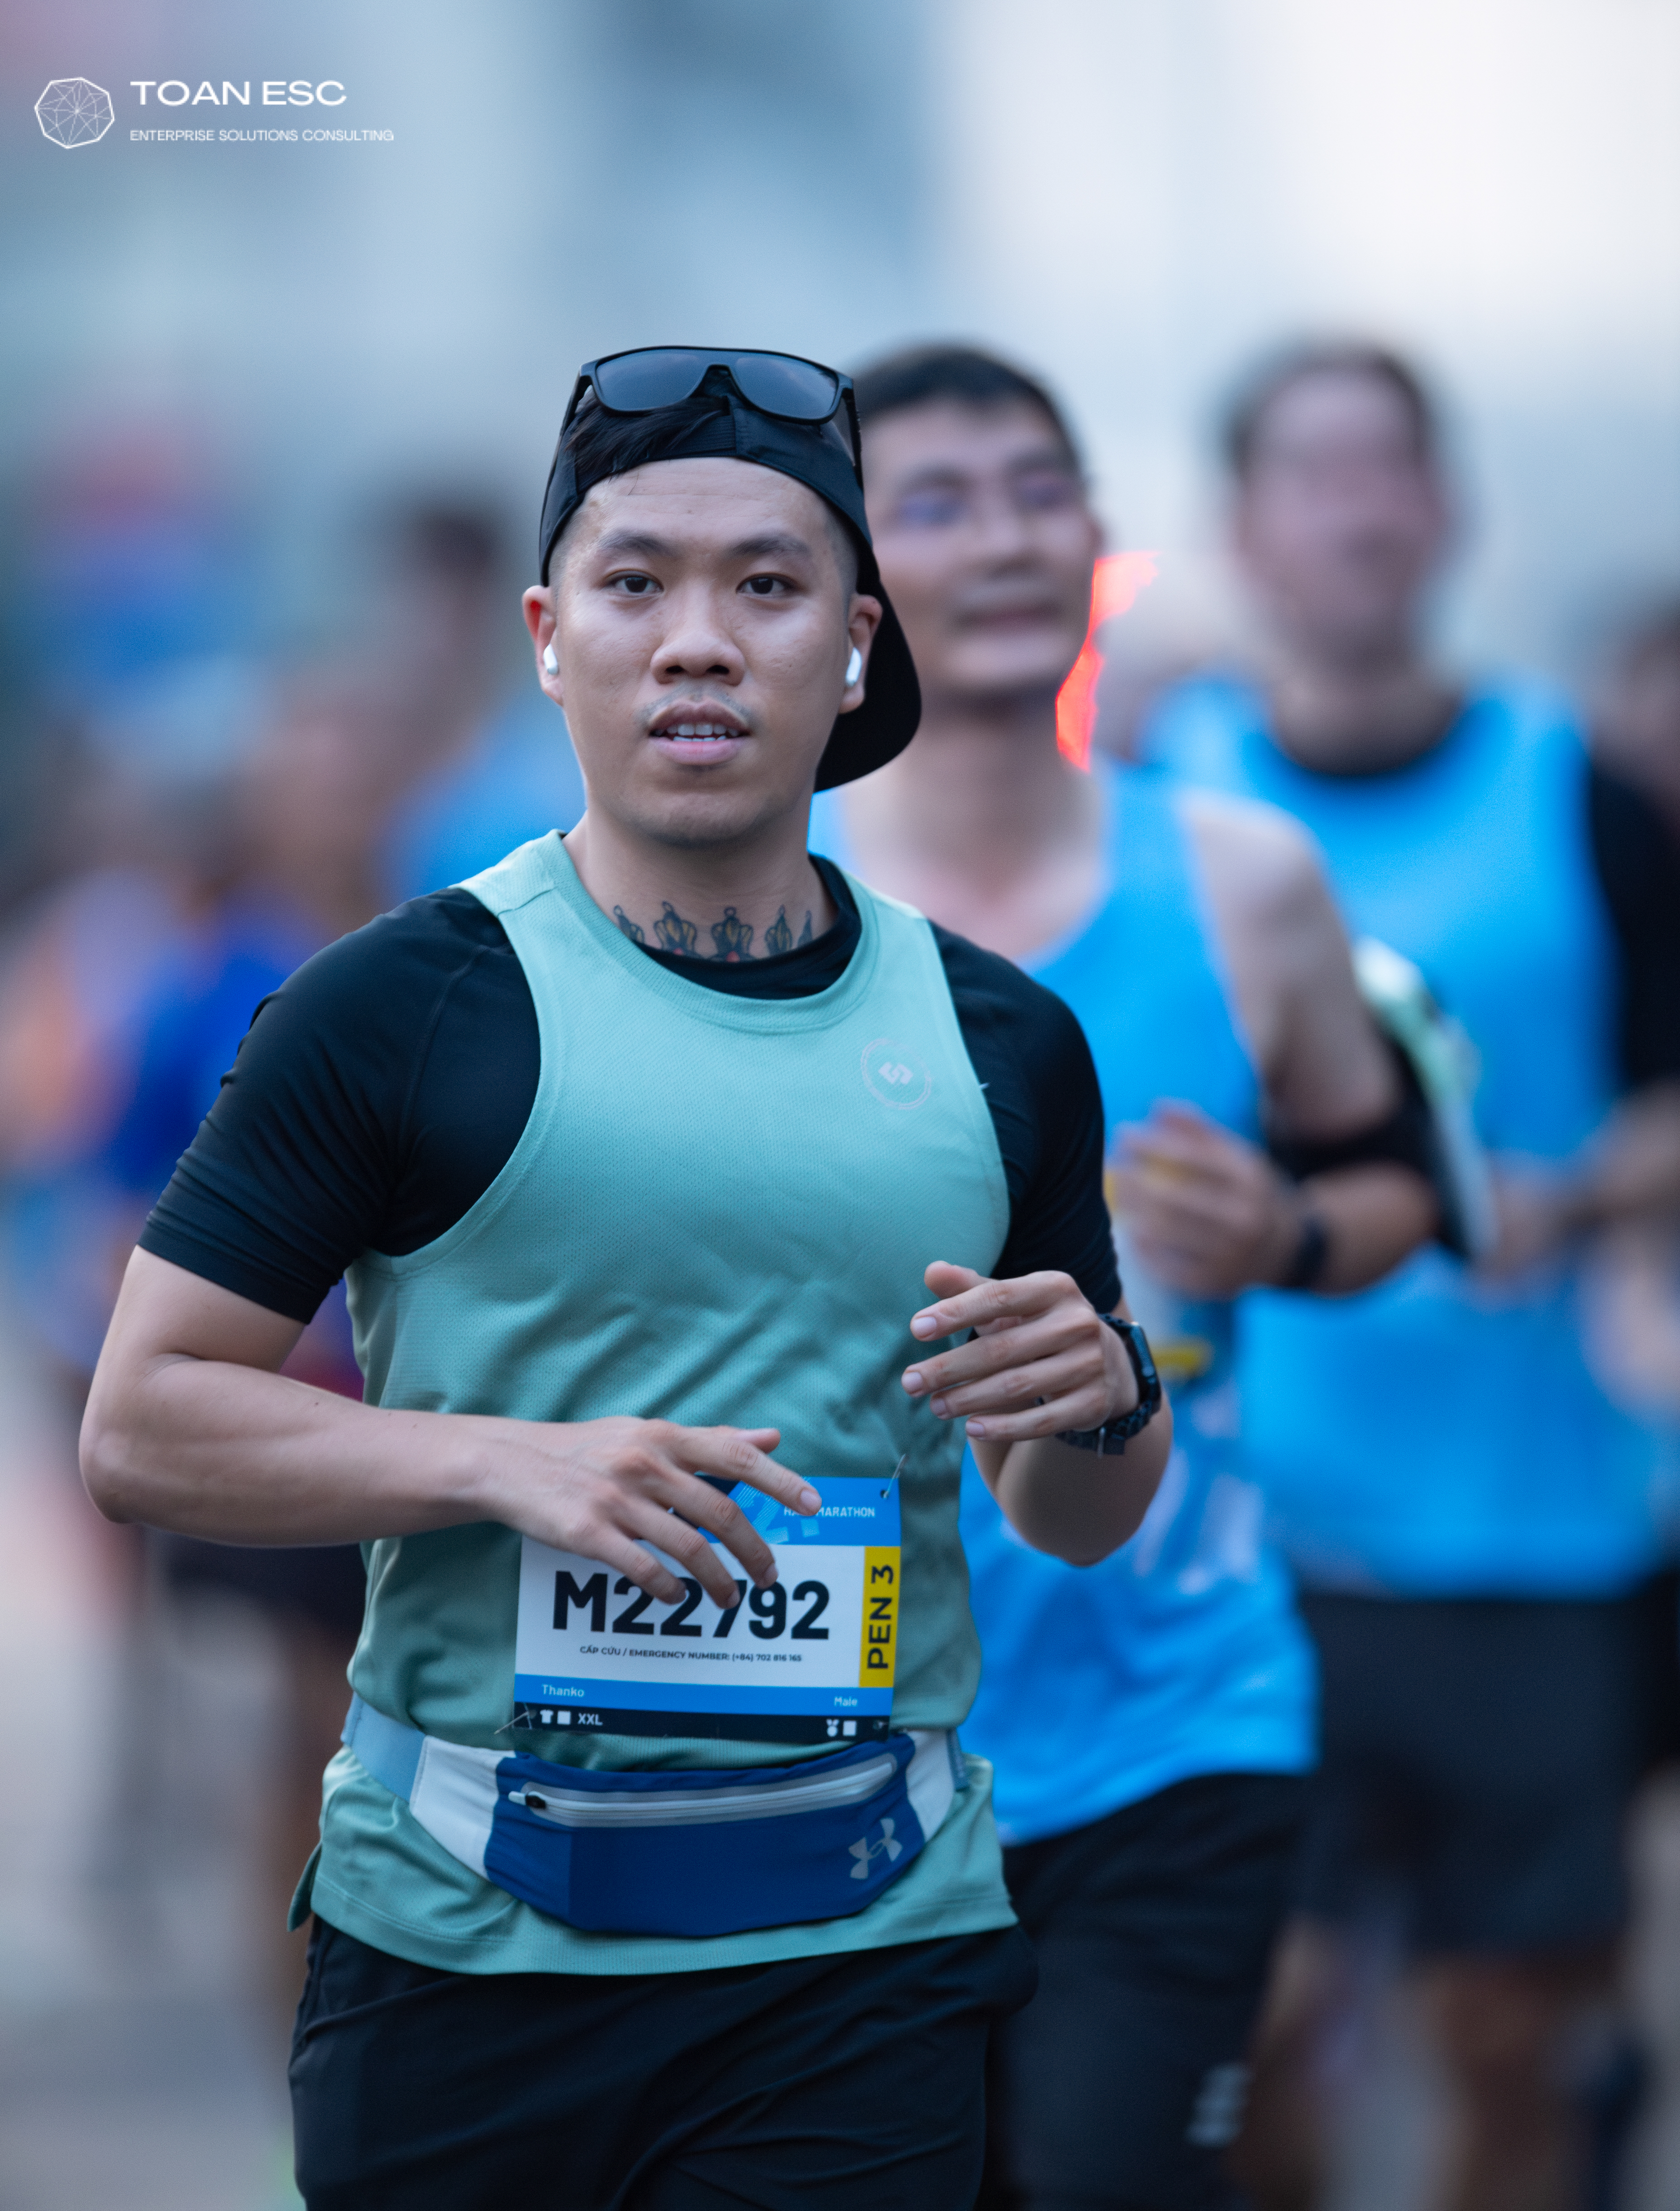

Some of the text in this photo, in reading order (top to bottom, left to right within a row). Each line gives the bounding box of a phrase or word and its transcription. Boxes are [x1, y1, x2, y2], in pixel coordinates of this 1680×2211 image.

[816, 1507, 875, 1517] MARATHON
[552, 1570, 830, 1640] M22792
[867, 1564, 894, 1670] PEN 3
[629, 1649, 686, 1659] EMERGENCY
[688, 1652, 730, 1661] NUMBER:
[732, 1653, 753, 1662] (+84)
[543, 1684, 585, 1697] Thanko
[834, 1696, 858, 1707] Male
[578, 1713, 603, 1726] XXL
